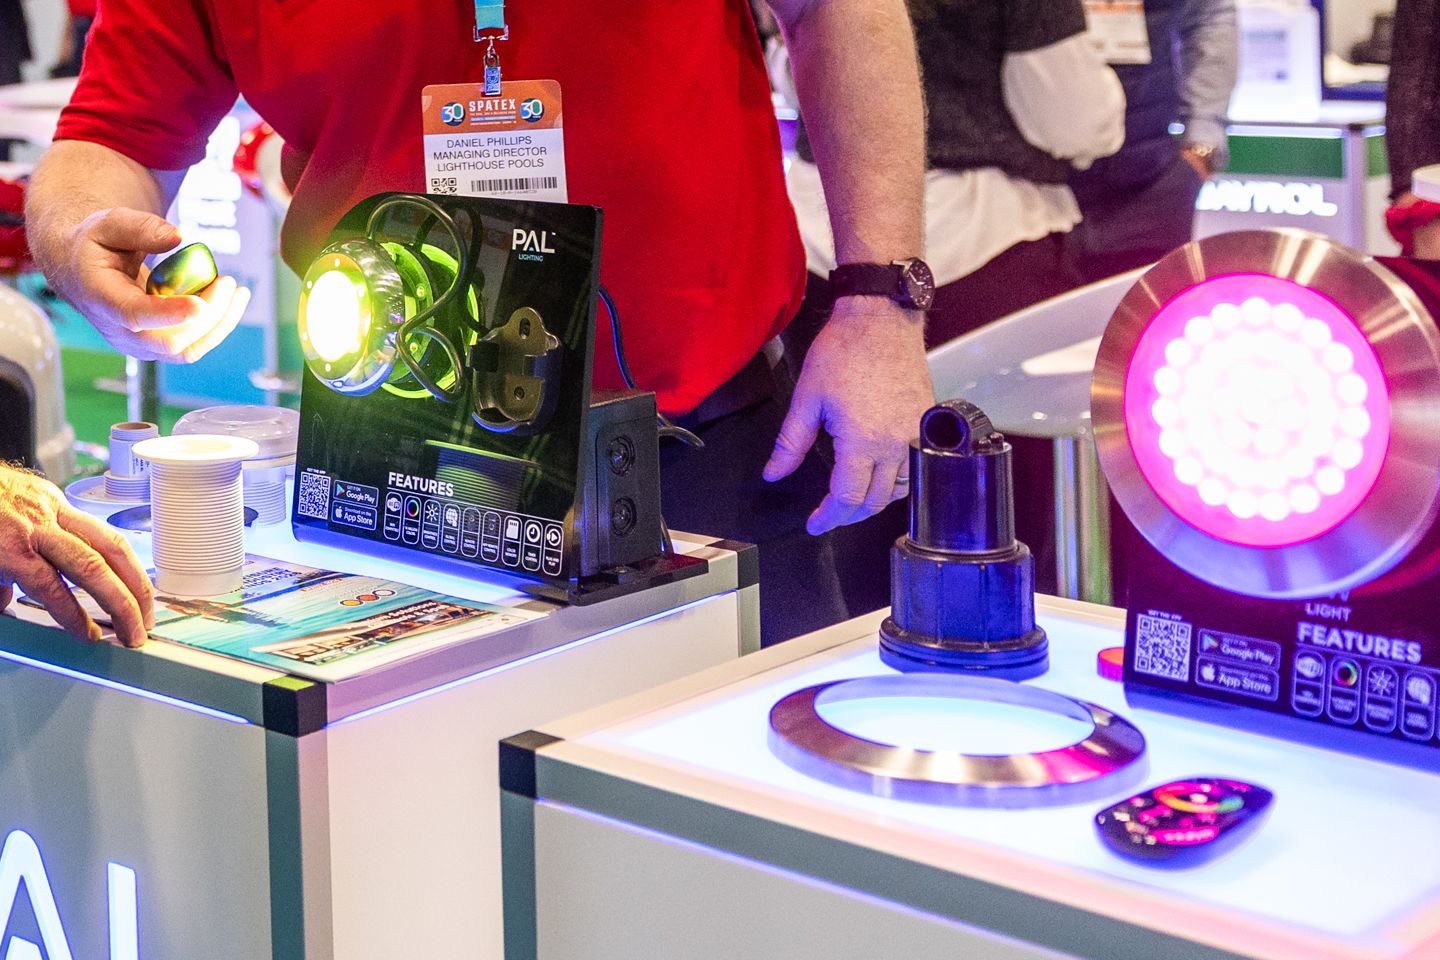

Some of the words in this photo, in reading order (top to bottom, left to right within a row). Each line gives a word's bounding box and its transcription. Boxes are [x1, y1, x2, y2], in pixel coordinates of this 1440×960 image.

[441, 103, 465, 122] 30
[468, 98, 516, 112] SPATEX
[520, 99, 543, 119] 30
[447, 138, 484, 149] DANIEL
[487, 136, 532, 147] PHILLIPS
[433, 148, 490, 161] MANAGING
[493, 146, 547, 158] DIRECTOR
[437, 160, 505, 172] LIGHTHOUSE
[508, 158, 544, 168] POOLS
[512, 228, 555, 253] PAL
[518, 254, 544, 262] LIGHTING
[388, 471, 454, 497] FEATURES
[346, 490, 364, 501] Google
[364, 494, 375, 504] Play
[344, 512, 356, 523] App
[357, 515, 373, 525] Store
[1305, 603, 1351, 622] LIGHT
[1297, 621, 1422, 664] FEATURES
[1221, 643, 1253, 661] Google
[1254, 649, 1275, 665] Play
[1218, 673, 1241, 688] App
[1243, 676, 1272, 695] Store
